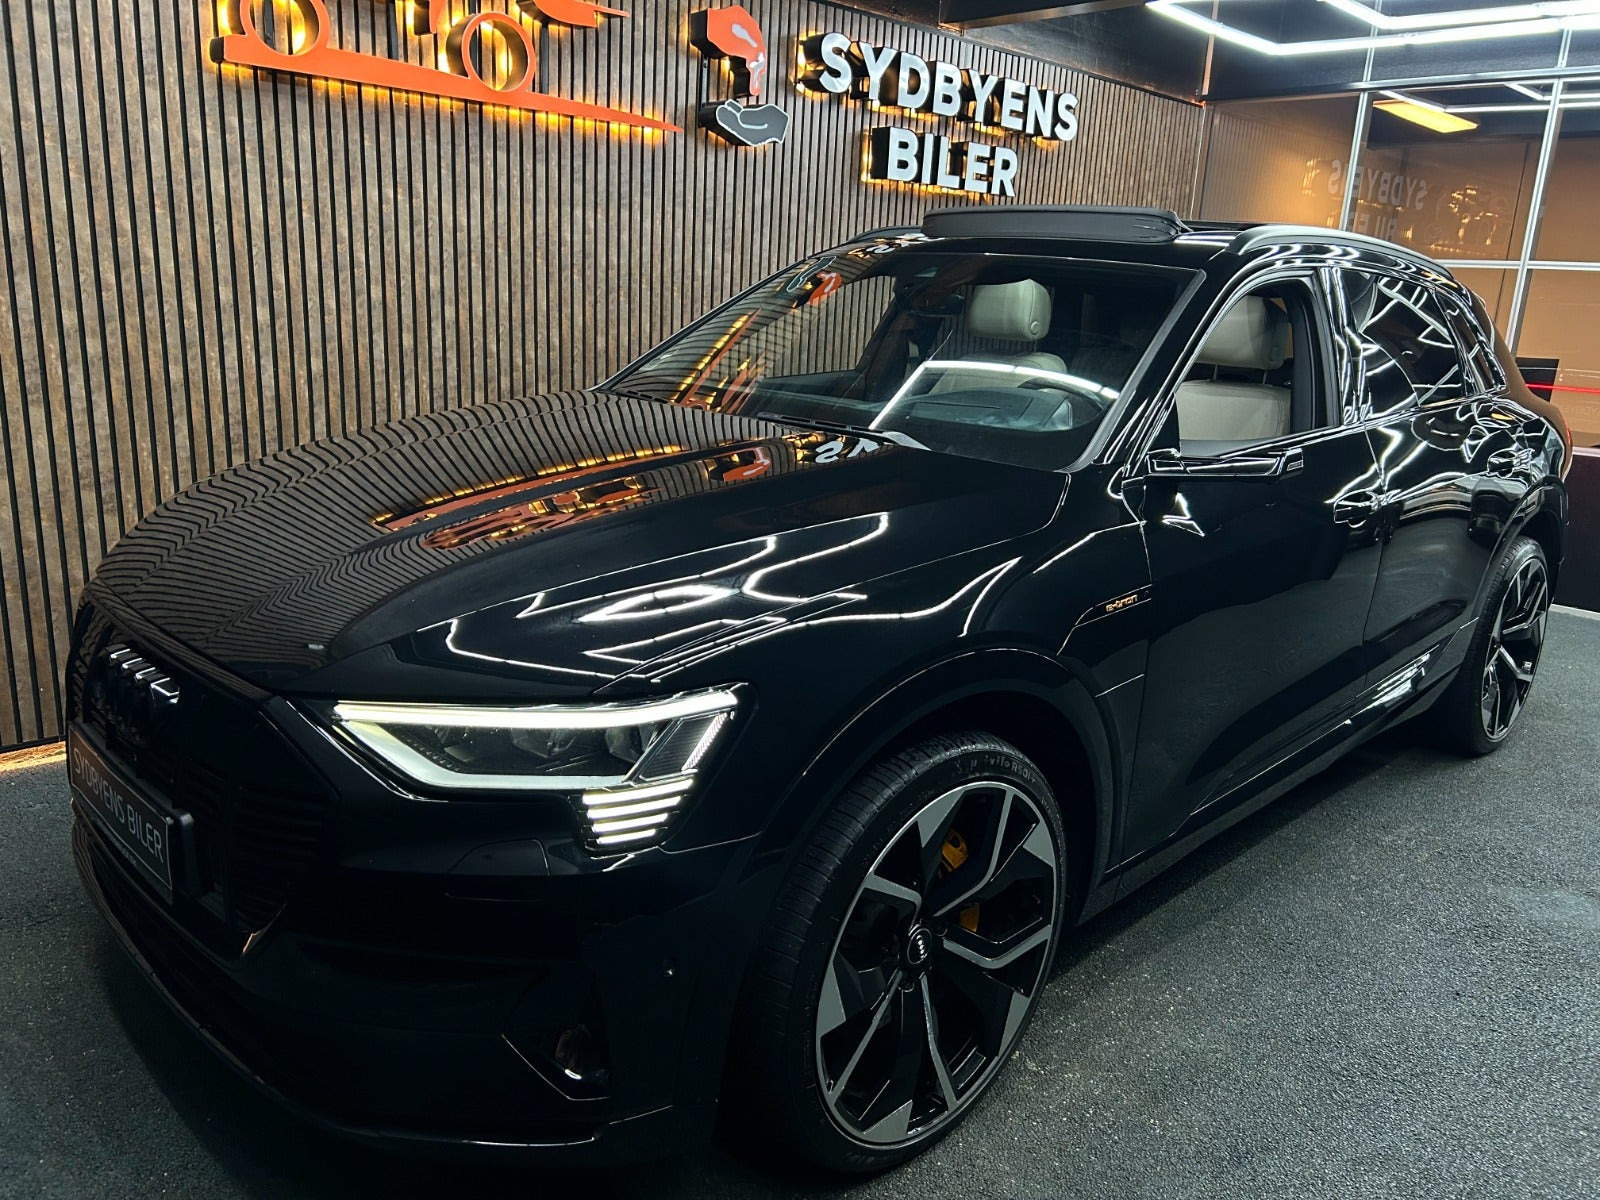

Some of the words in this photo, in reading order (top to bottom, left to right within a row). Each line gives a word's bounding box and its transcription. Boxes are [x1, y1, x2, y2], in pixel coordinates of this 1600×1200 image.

[819, 32, 1079, 142] SYDBYENS
[887, 126, 1018, 197] BILER
[1105, 594, 1138, 612] e-tron
[73, 747, 125, 824] SYDBYENS
[126, 803, 164, 864] BILER
